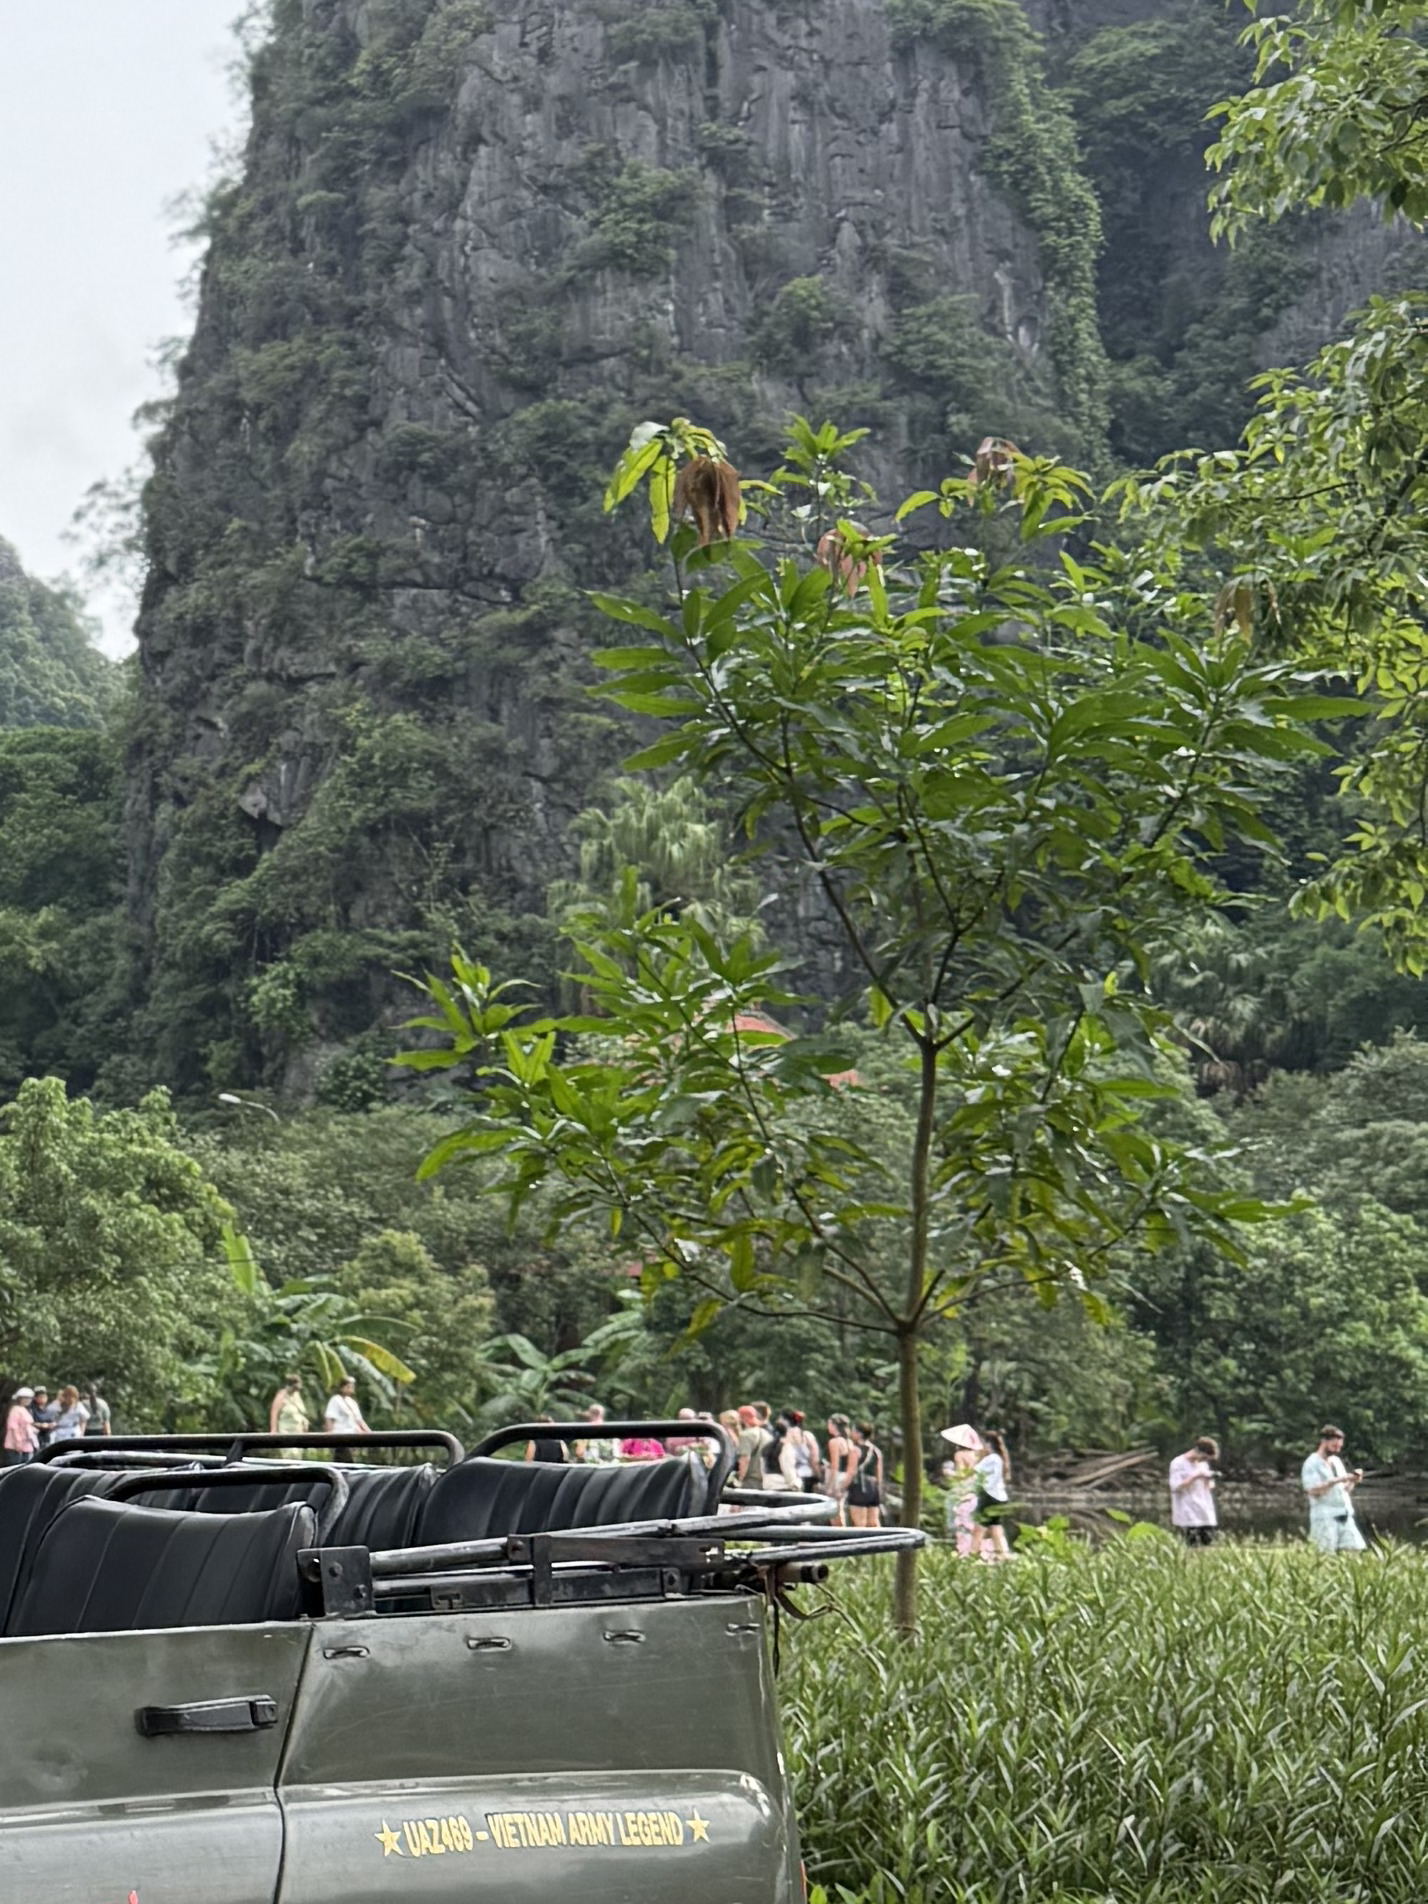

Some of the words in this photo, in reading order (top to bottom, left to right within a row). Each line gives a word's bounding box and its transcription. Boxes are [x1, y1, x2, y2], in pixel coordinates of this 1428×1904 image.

[402, 1815, 473, 1857] UAZ469
[486, 1811, 567, 1848] VIETNAM
[568, 1811, 614, 1845] ARMY
[615, 1811, 684, 1845] LEGEND
